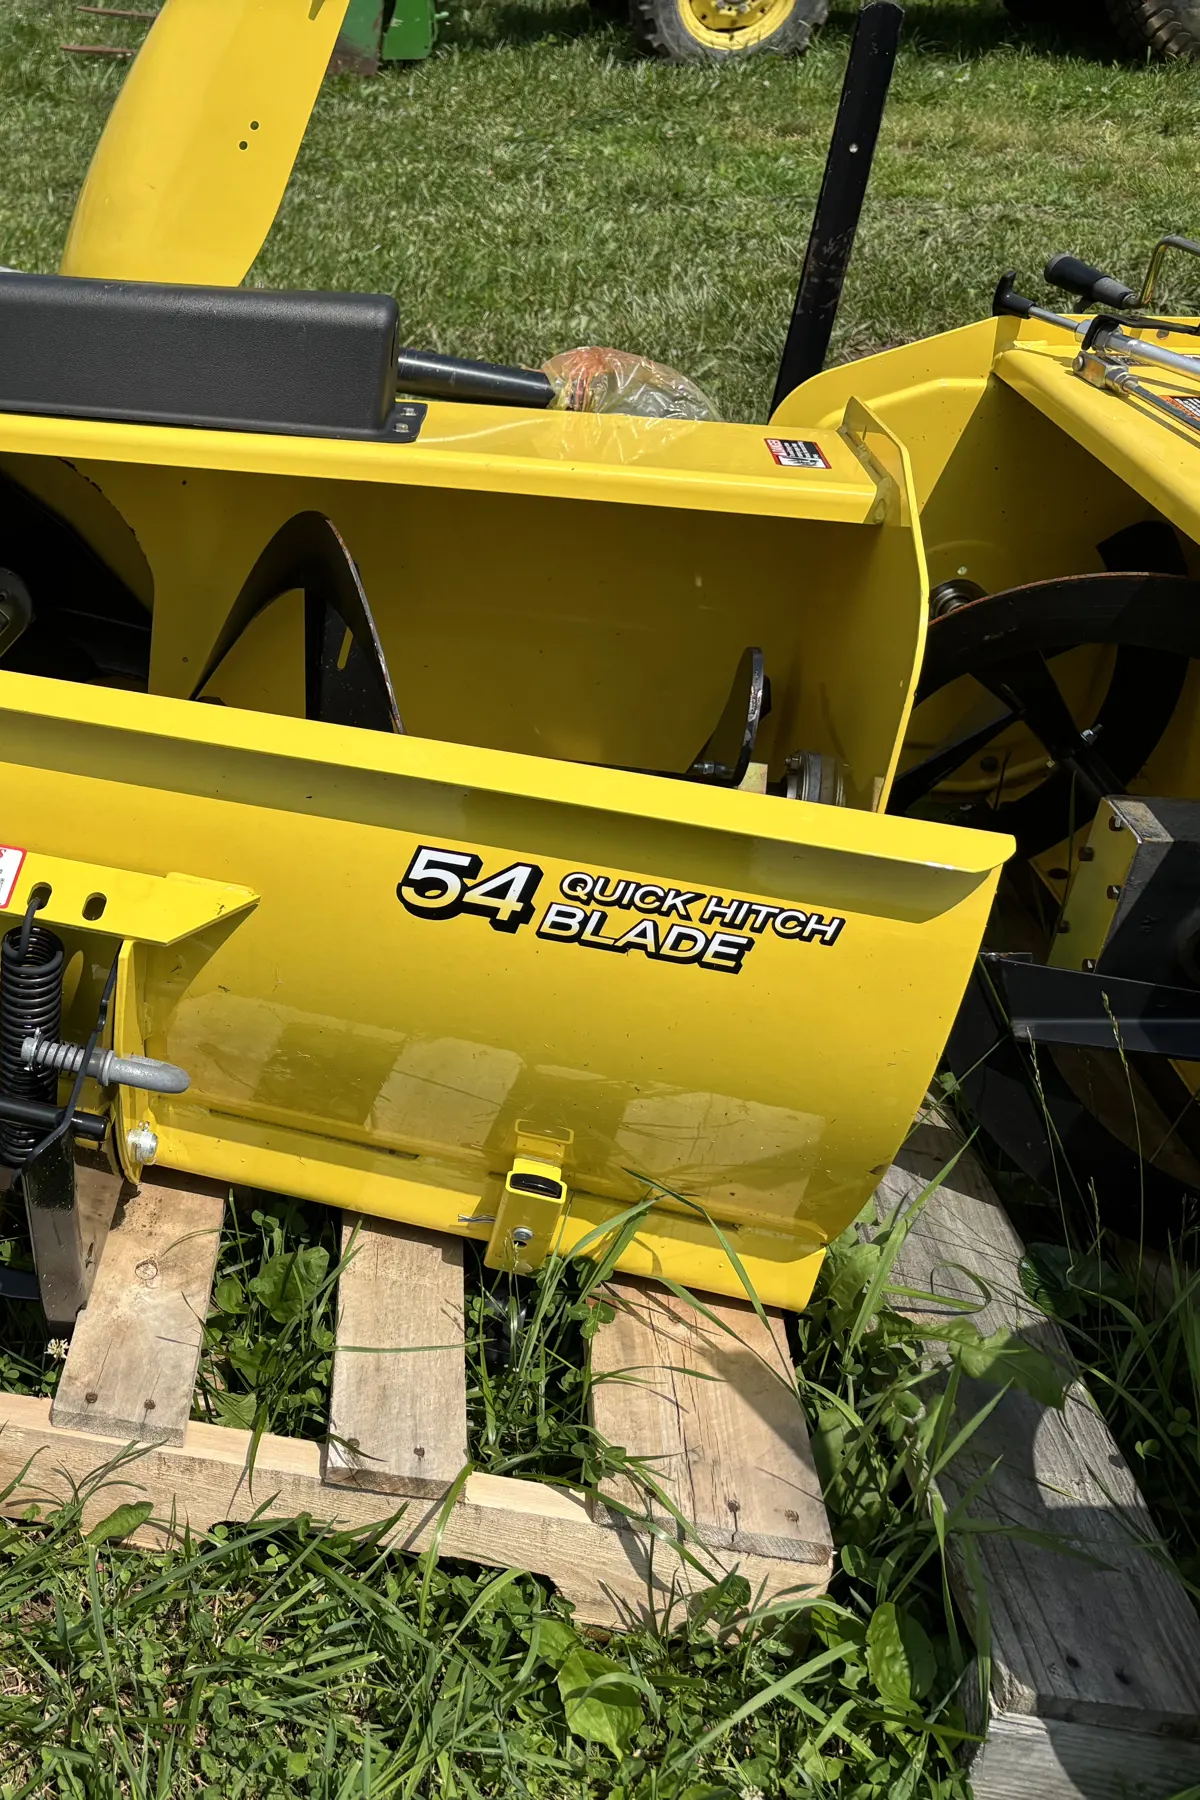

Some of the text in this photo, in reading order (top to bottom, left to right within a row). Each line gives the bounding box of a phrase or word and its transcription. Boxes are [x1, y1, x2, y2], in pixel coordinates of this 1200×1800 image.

[396, 844, 544, 934] 54
[560, 871, 846, 946] QUICK HITCH
[536, 902, 755, 974] BLADE
